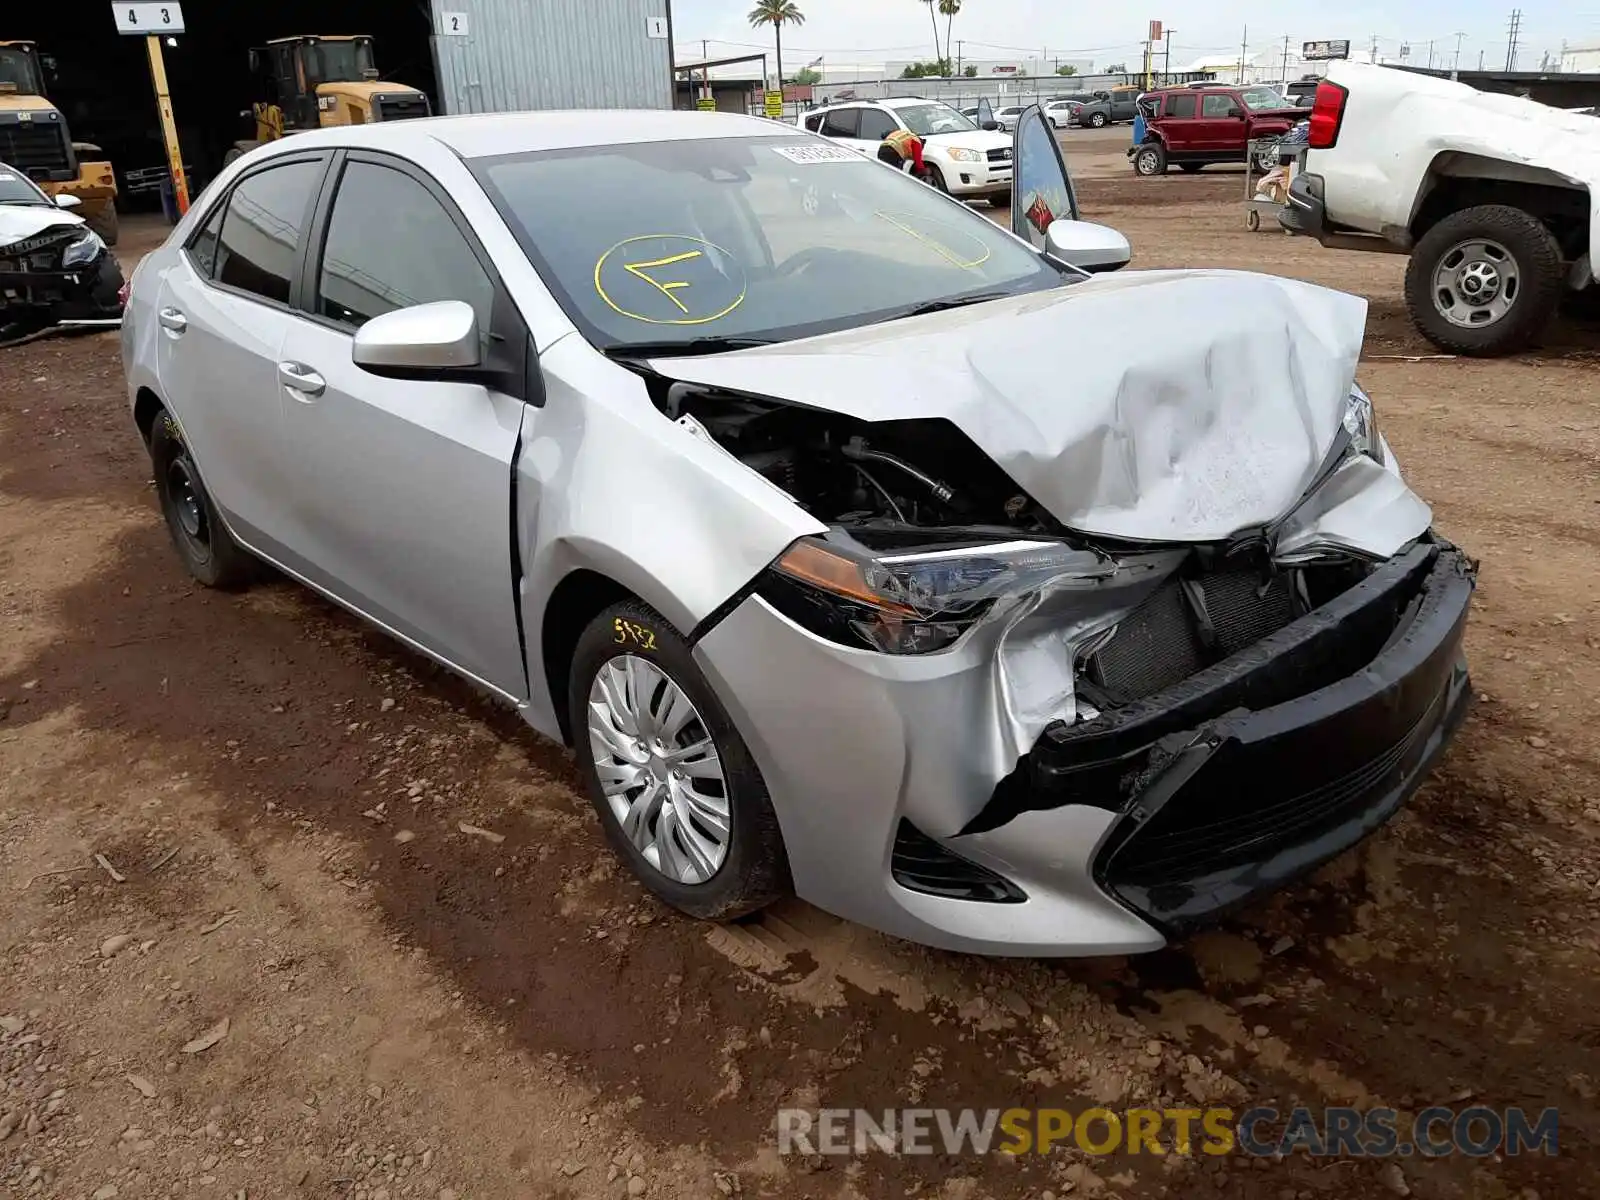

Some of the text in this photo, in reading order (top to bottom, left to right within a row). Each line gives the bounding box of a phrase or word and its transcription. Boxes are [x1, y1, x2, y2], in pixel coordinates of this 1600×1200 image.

[128, 8, 171, 25] 4 3
[451, 16, 460, 31] 2
